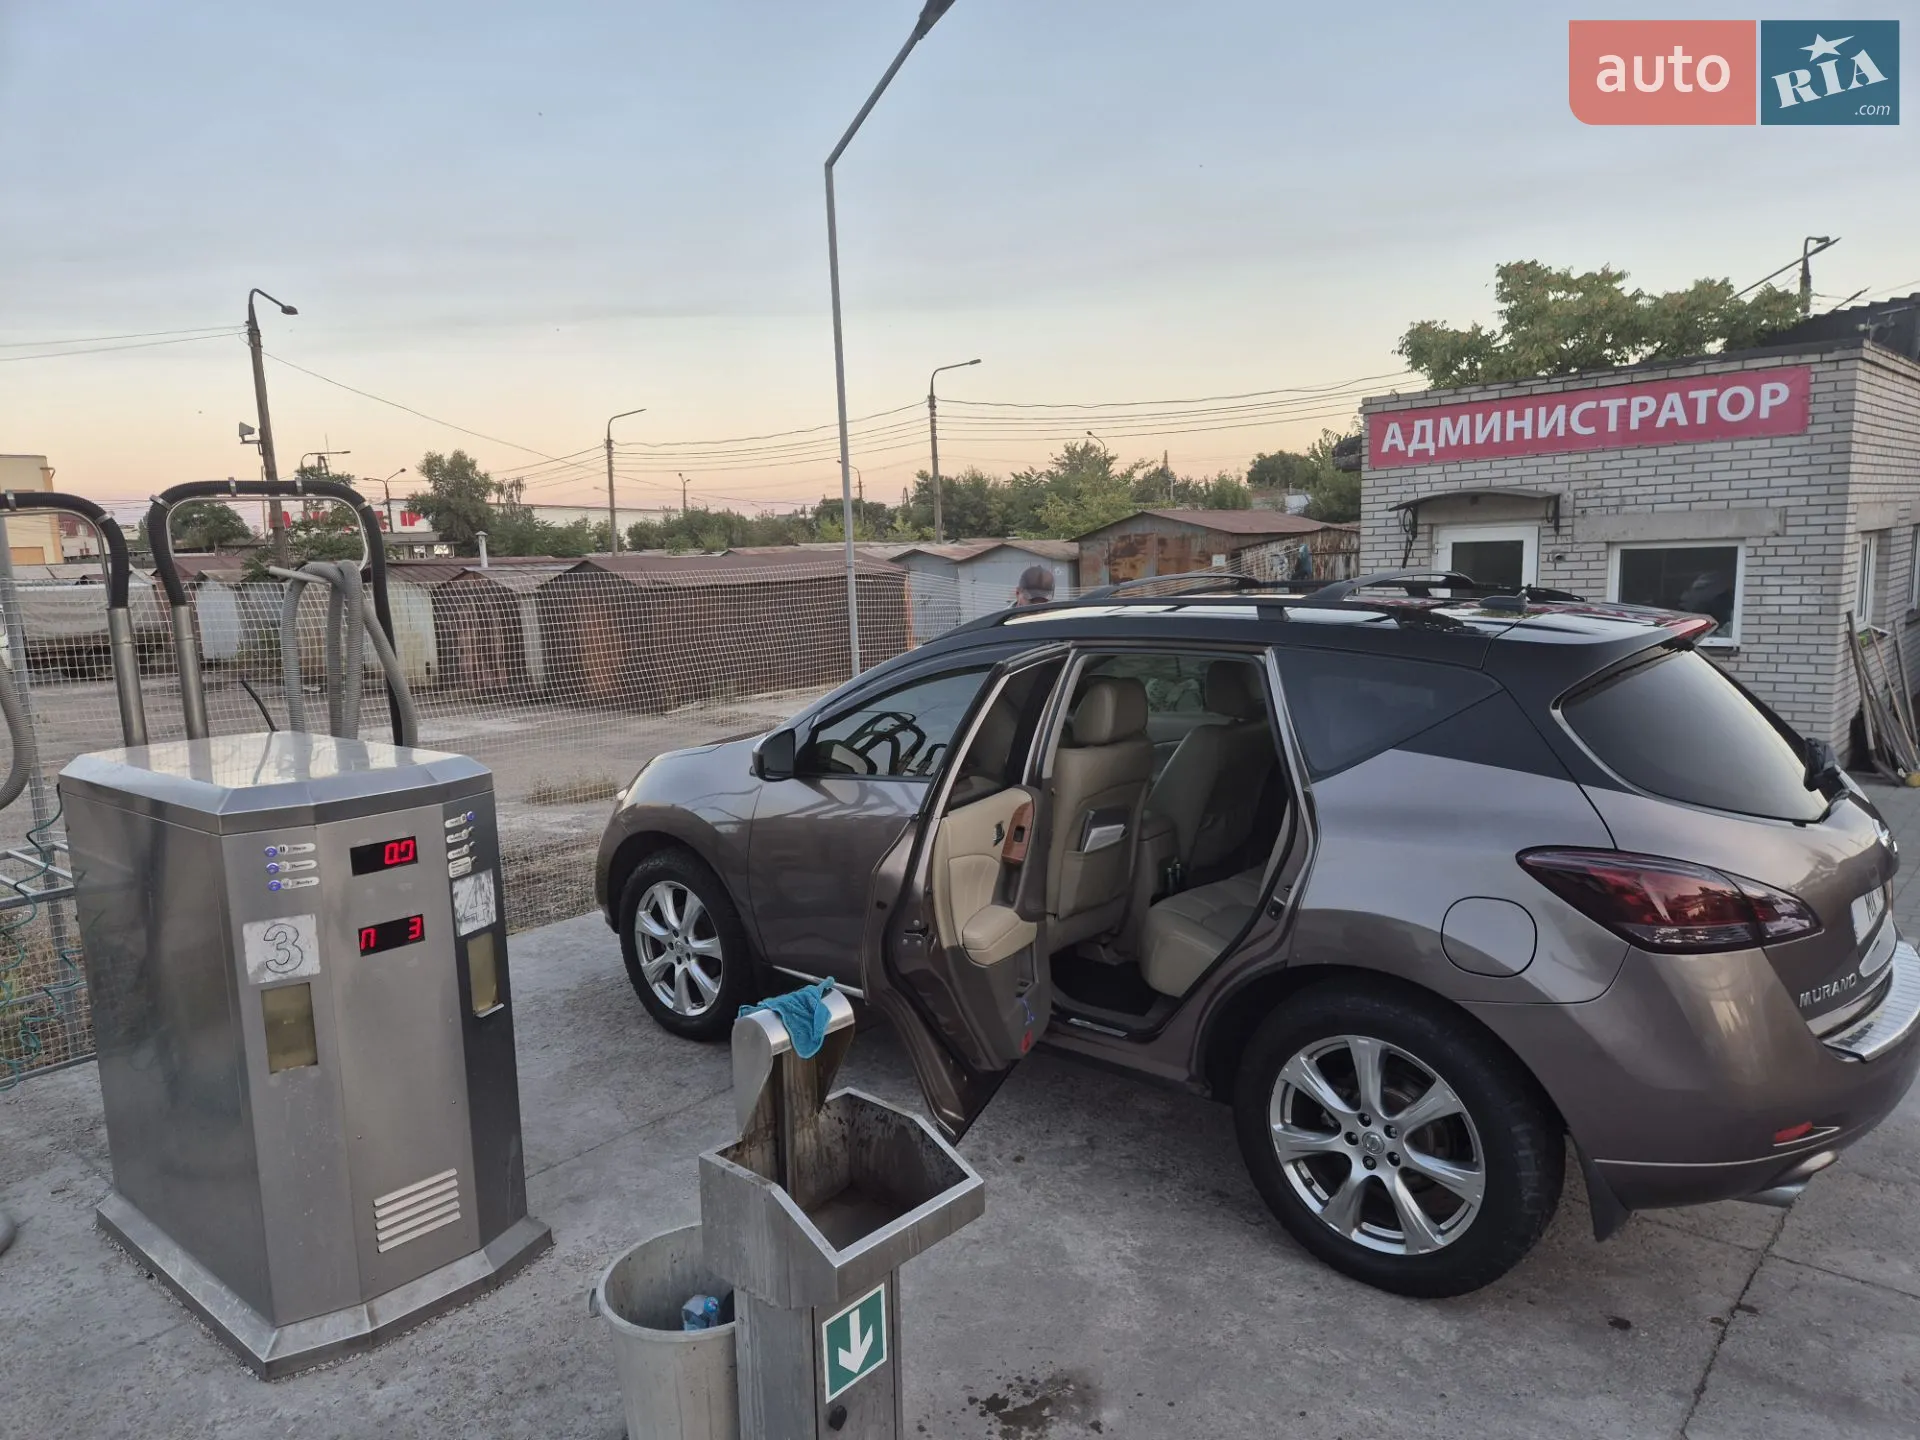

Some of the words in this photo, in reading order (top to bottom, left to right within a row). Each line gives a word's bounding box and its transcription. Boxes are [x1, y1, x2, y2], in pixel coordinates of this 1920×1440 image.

[1381, 382, 1790, 457] АДМИНИСТРАТОР
[264, 923, 303, 974] 3
[1799, 973, 1857, 1008] MURANO
